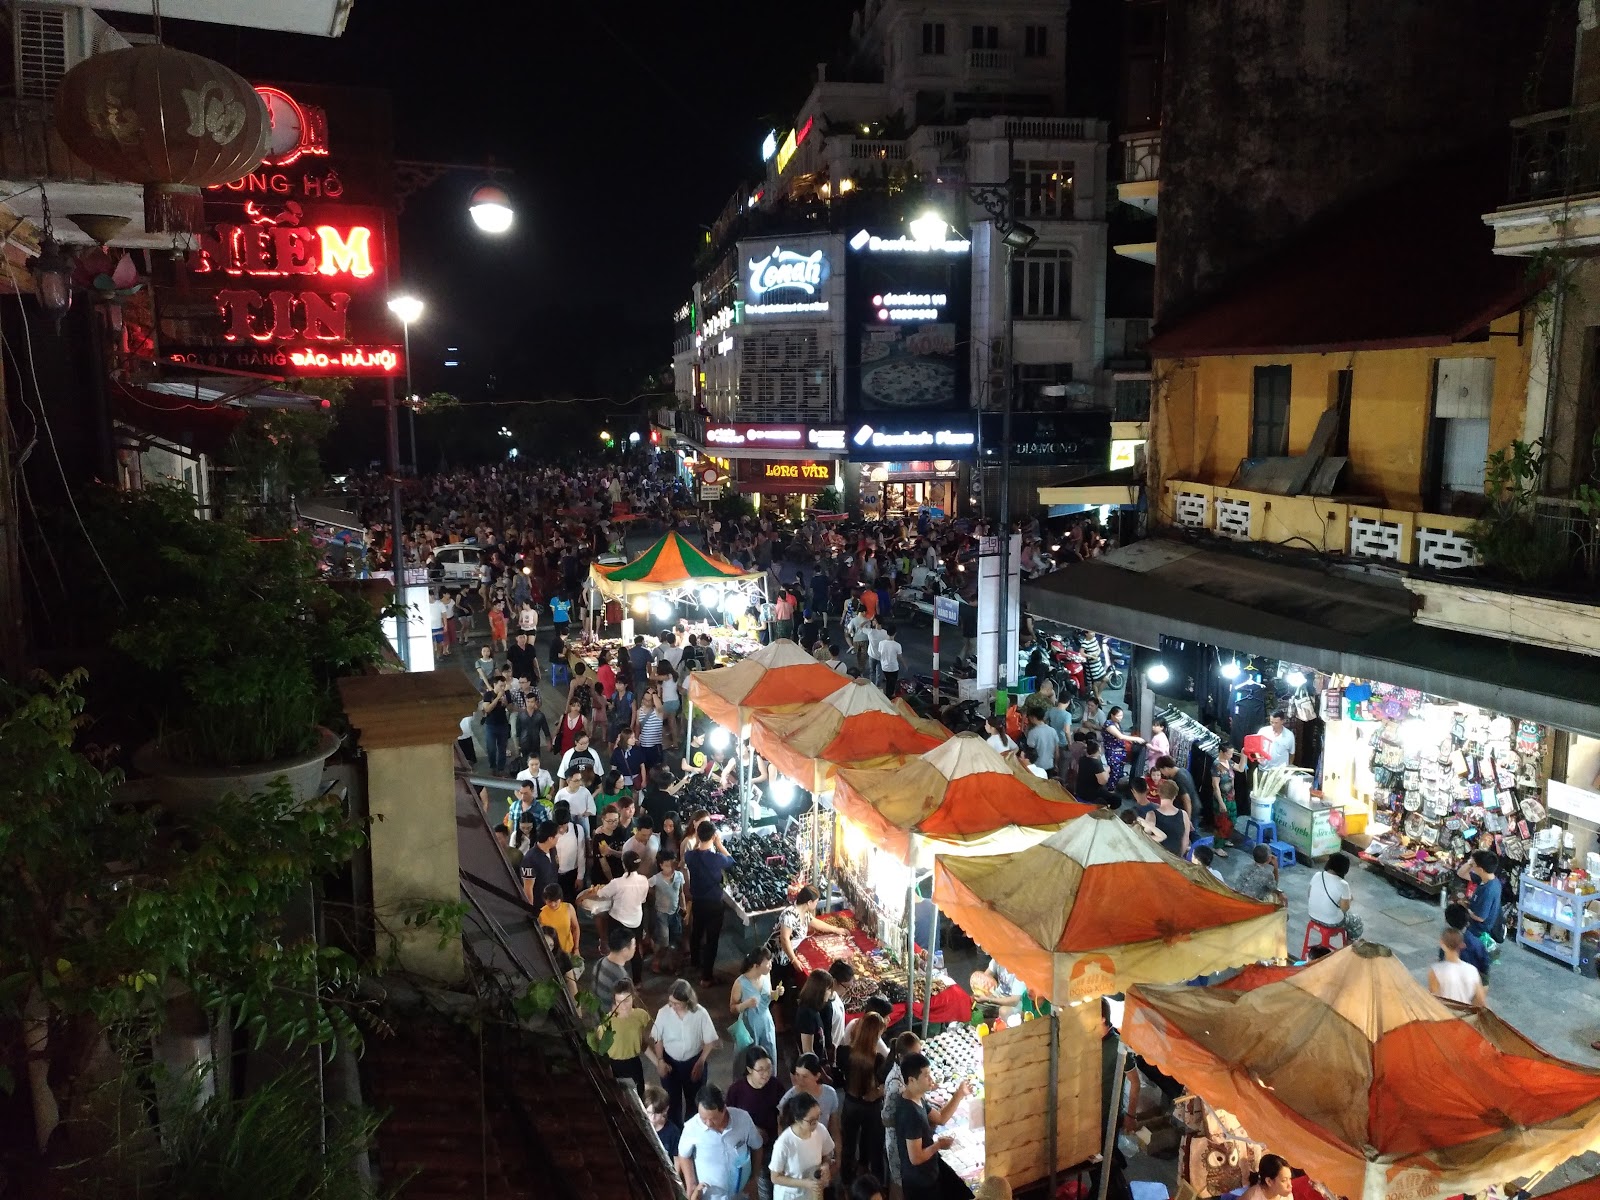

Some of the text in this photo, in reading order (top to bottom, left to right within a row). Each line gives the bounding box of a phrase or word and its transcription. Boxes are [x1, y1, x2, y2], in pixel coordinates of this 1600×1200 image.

[215, 289, 351, 341] TIN
[1015, 443, 1078, 454] DIAMOND
[765, 464, 799, 477] LONG
[521, 867, 533, 877] VII
